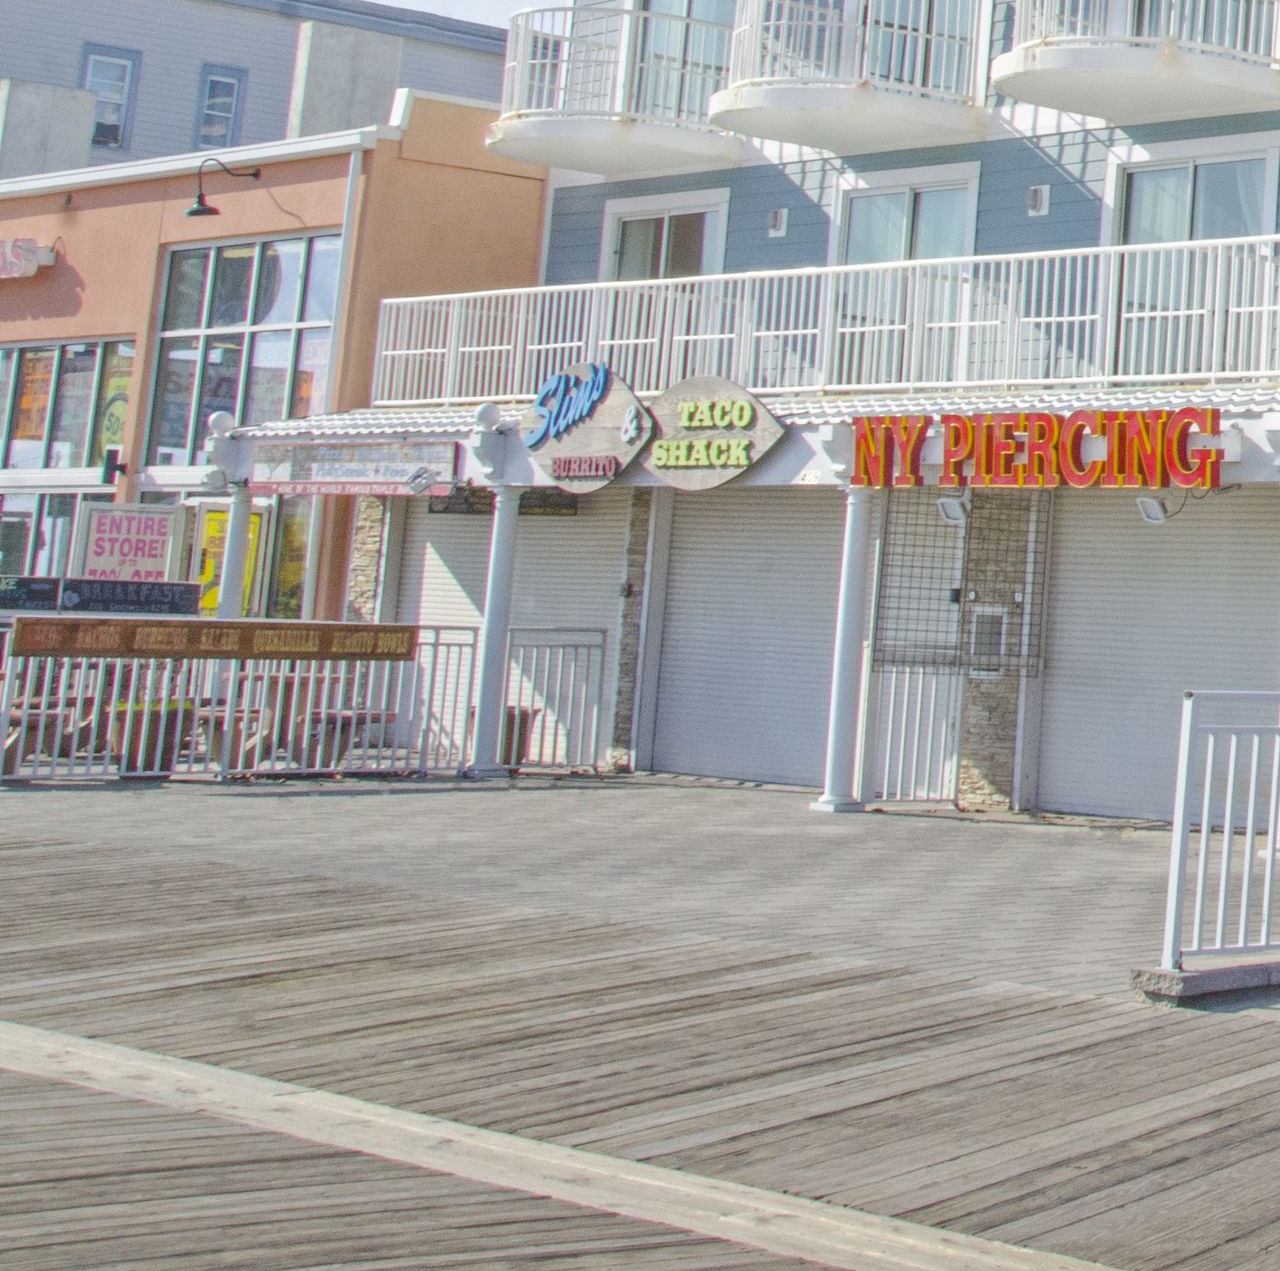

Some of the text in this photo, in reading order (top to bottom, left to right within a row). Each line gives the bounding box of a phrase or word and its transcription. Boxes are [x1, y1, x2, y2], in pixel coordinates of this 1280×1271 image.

[523, 361, 607, 449] Slim's
[677, 399, 757, 429] TACO
[621, 405, 642, 444] &
[652, 438, 752, 469] SHACK
[850, 406, 1226, 490] NY PIERCING
[552, 454, 620, 479] BURRITO
[96, 514, 169, 537] ENTIRE
[94, 536, 166, 559] STORE!
[80, 582, 185, 602] BREAKFAST
